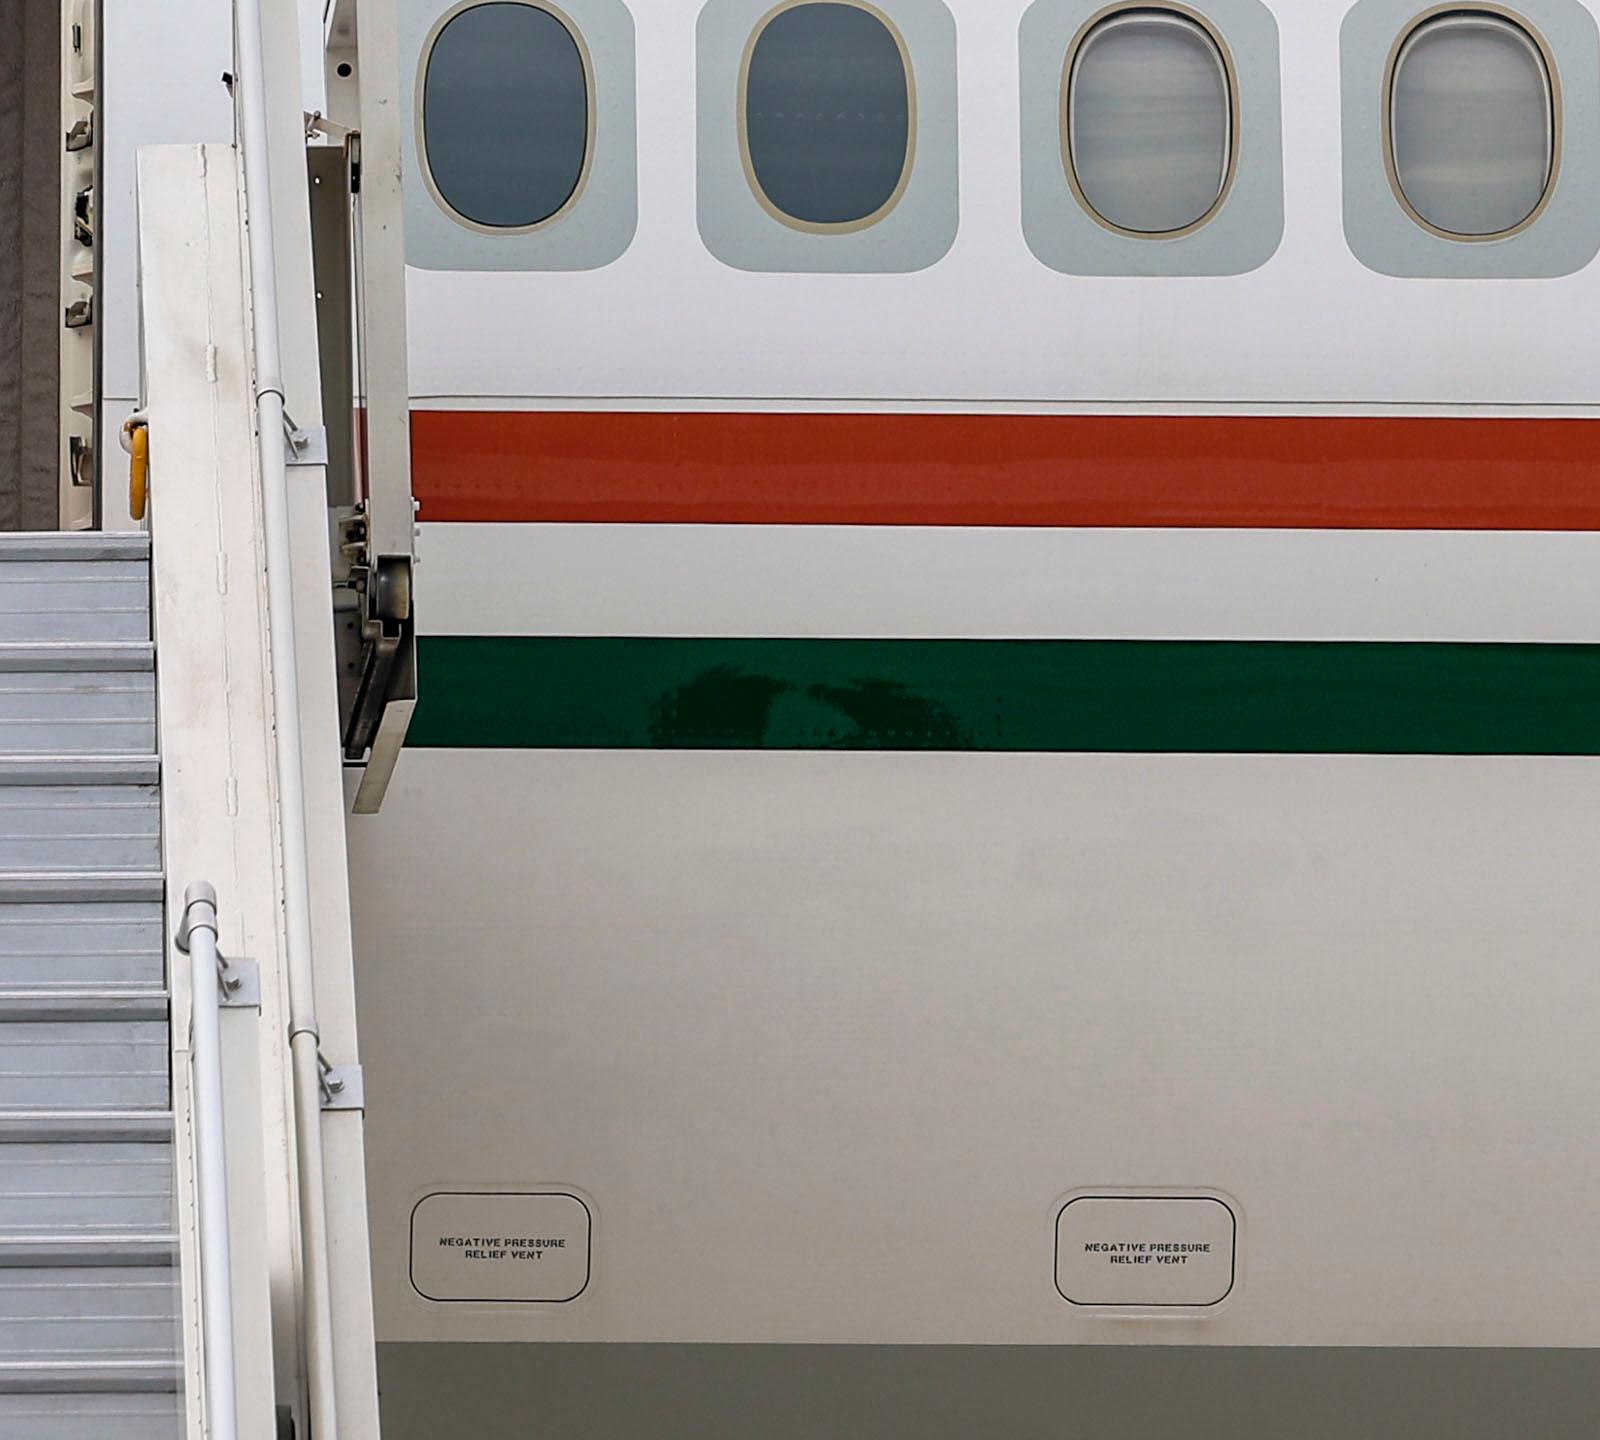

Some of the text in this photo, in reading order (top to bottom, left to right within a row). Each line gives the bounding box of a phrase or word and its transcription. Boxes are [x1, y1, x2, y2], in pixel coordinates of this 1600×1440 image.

[439, 1237, 566, 1248] NEGATIVE PRESSURE
[1084, 1243, 1211, 1253] NEGATIVE PRESSURE
[465, 1250, 543, 1260] RELIEF VENT
[1110, 1255, 1188, 1264] RELIEF VENT
